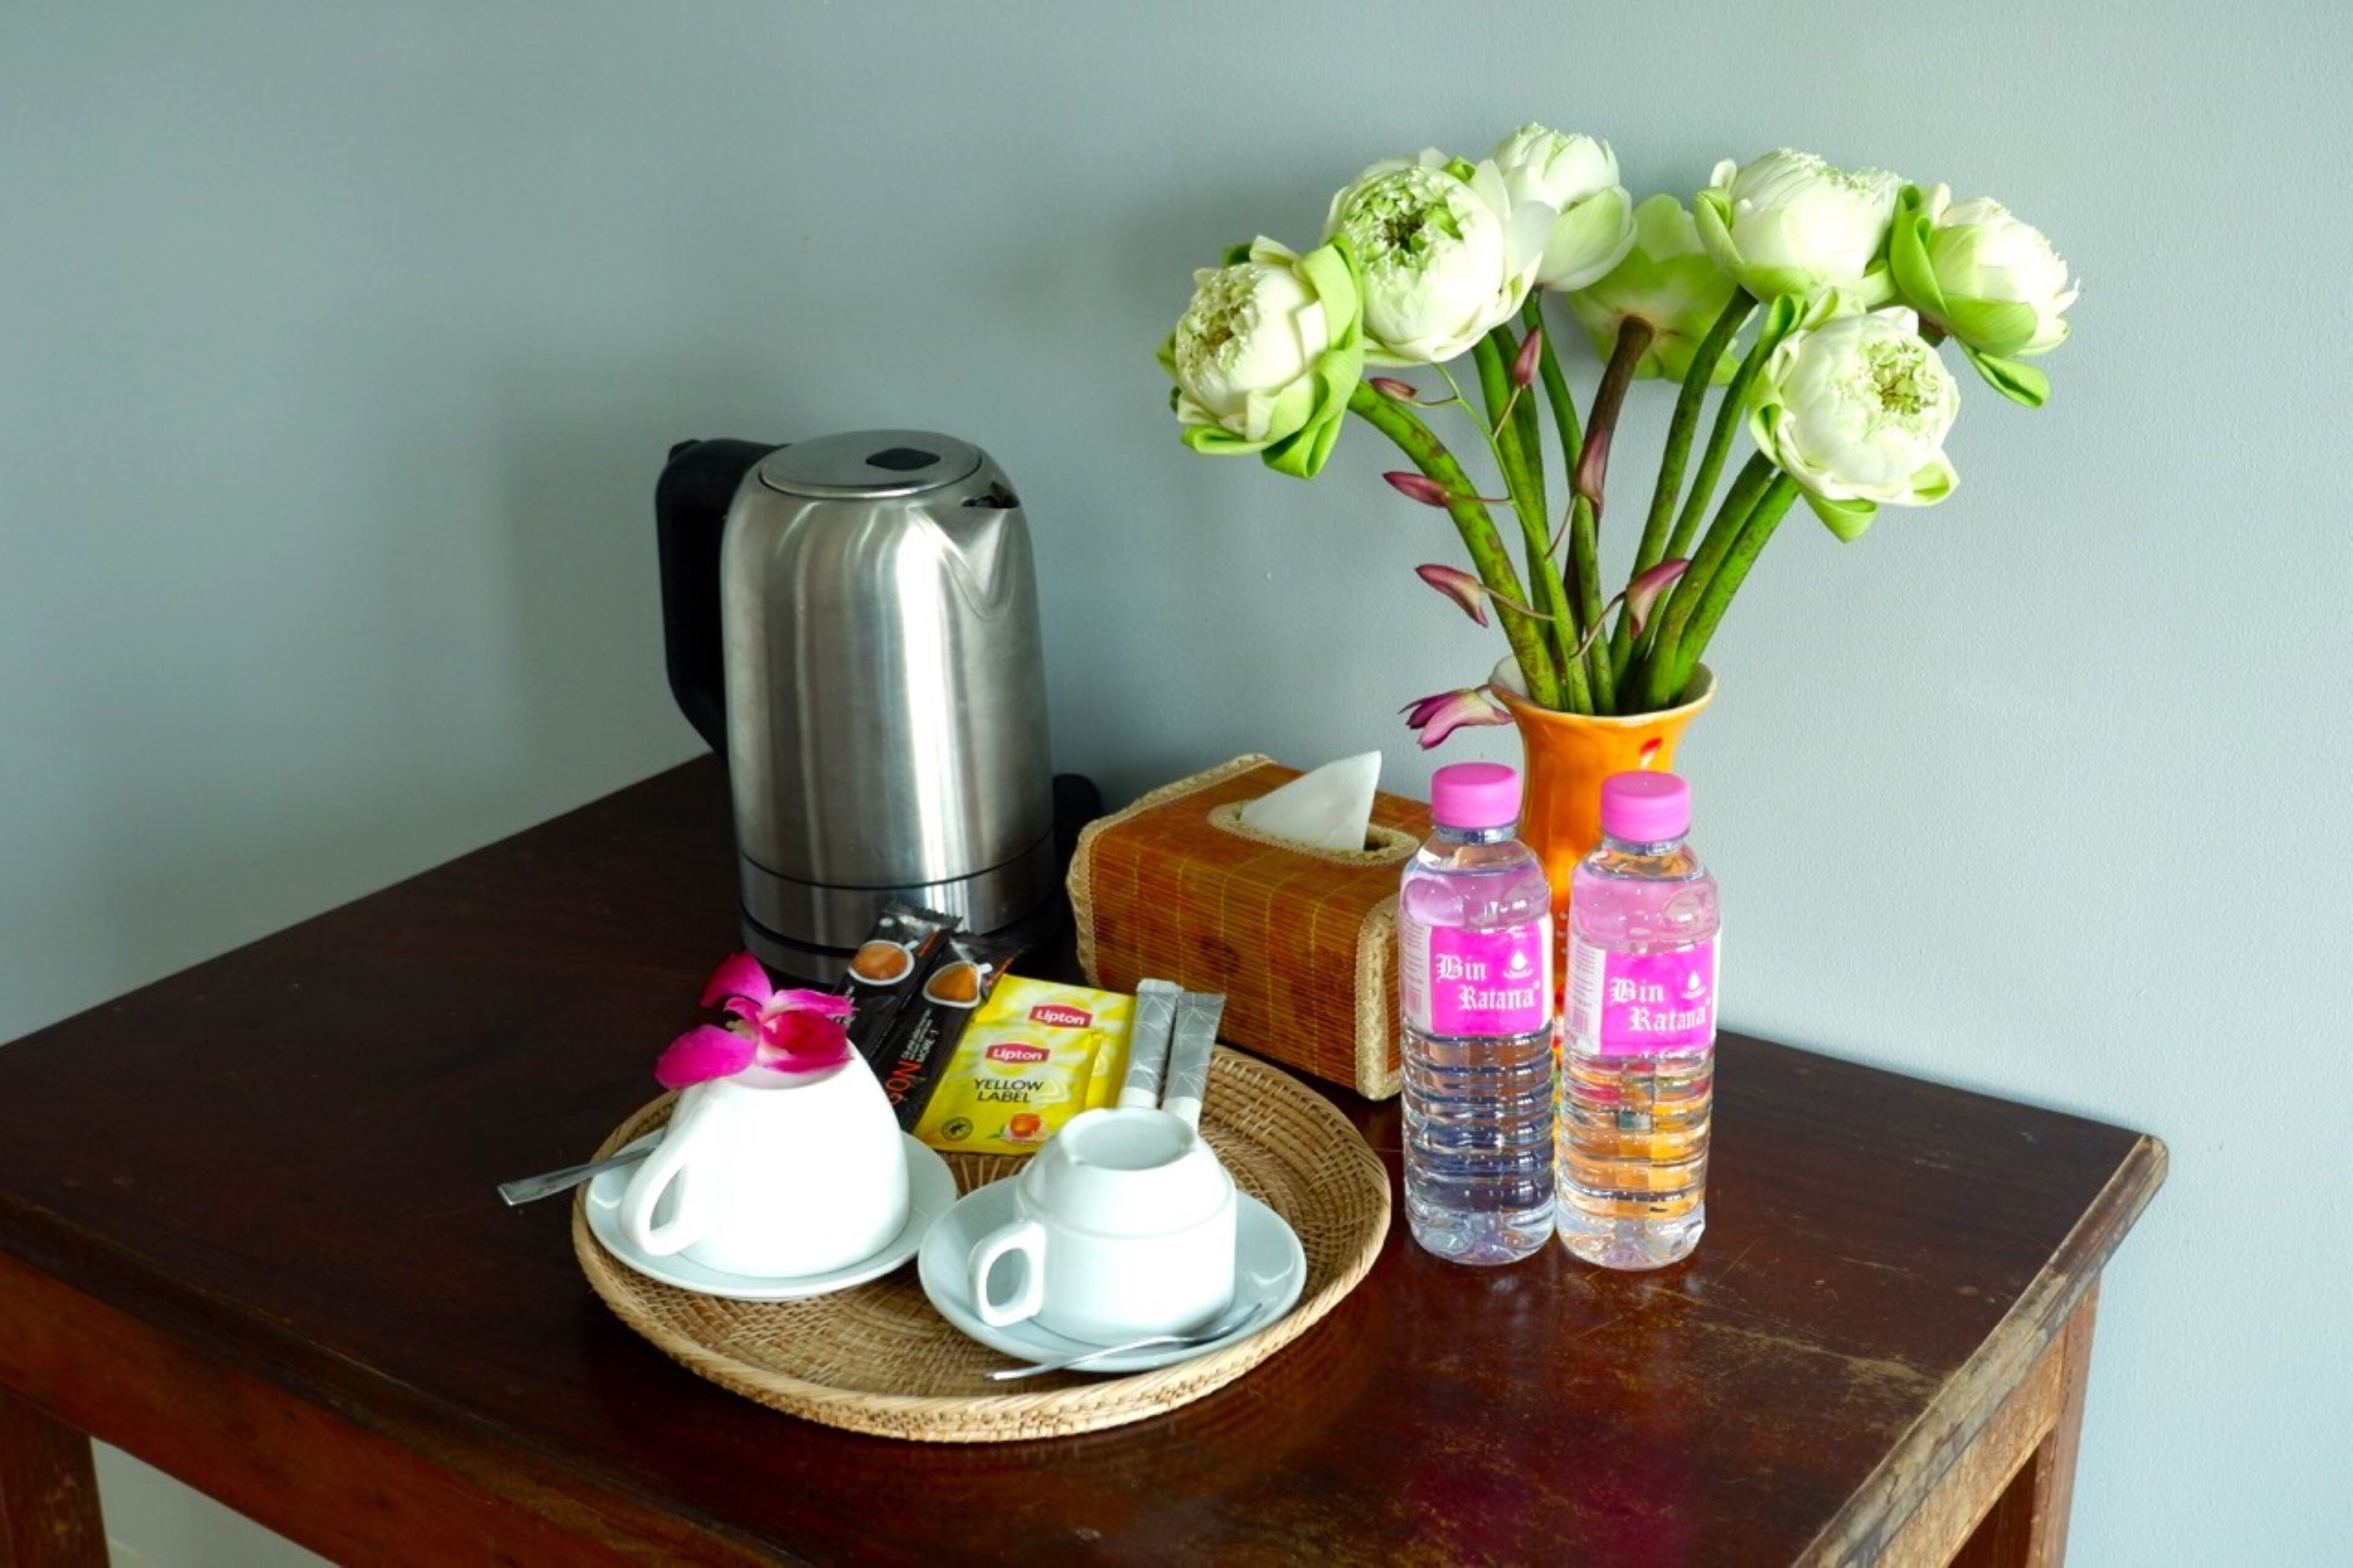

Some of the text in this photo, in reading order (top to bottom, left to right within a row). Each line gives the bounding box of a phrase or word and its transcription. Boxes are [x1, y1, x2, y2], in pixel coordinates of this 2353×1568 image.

[1436, 953, 1487, 983] Bin
[1458, 984, 1535, 1011] Ratana
[1609, 977, 1664, 1007] Bin
[1036, 1010, 1085, 1026] Lipton
[1628, 1006, 1707, 1032] Ratana
[992, 1048, 1043, 1061] Lipton
[975, 1078, 1044, 1091] YELLOW
[977, 1091, 1032, 1103] LABEL
